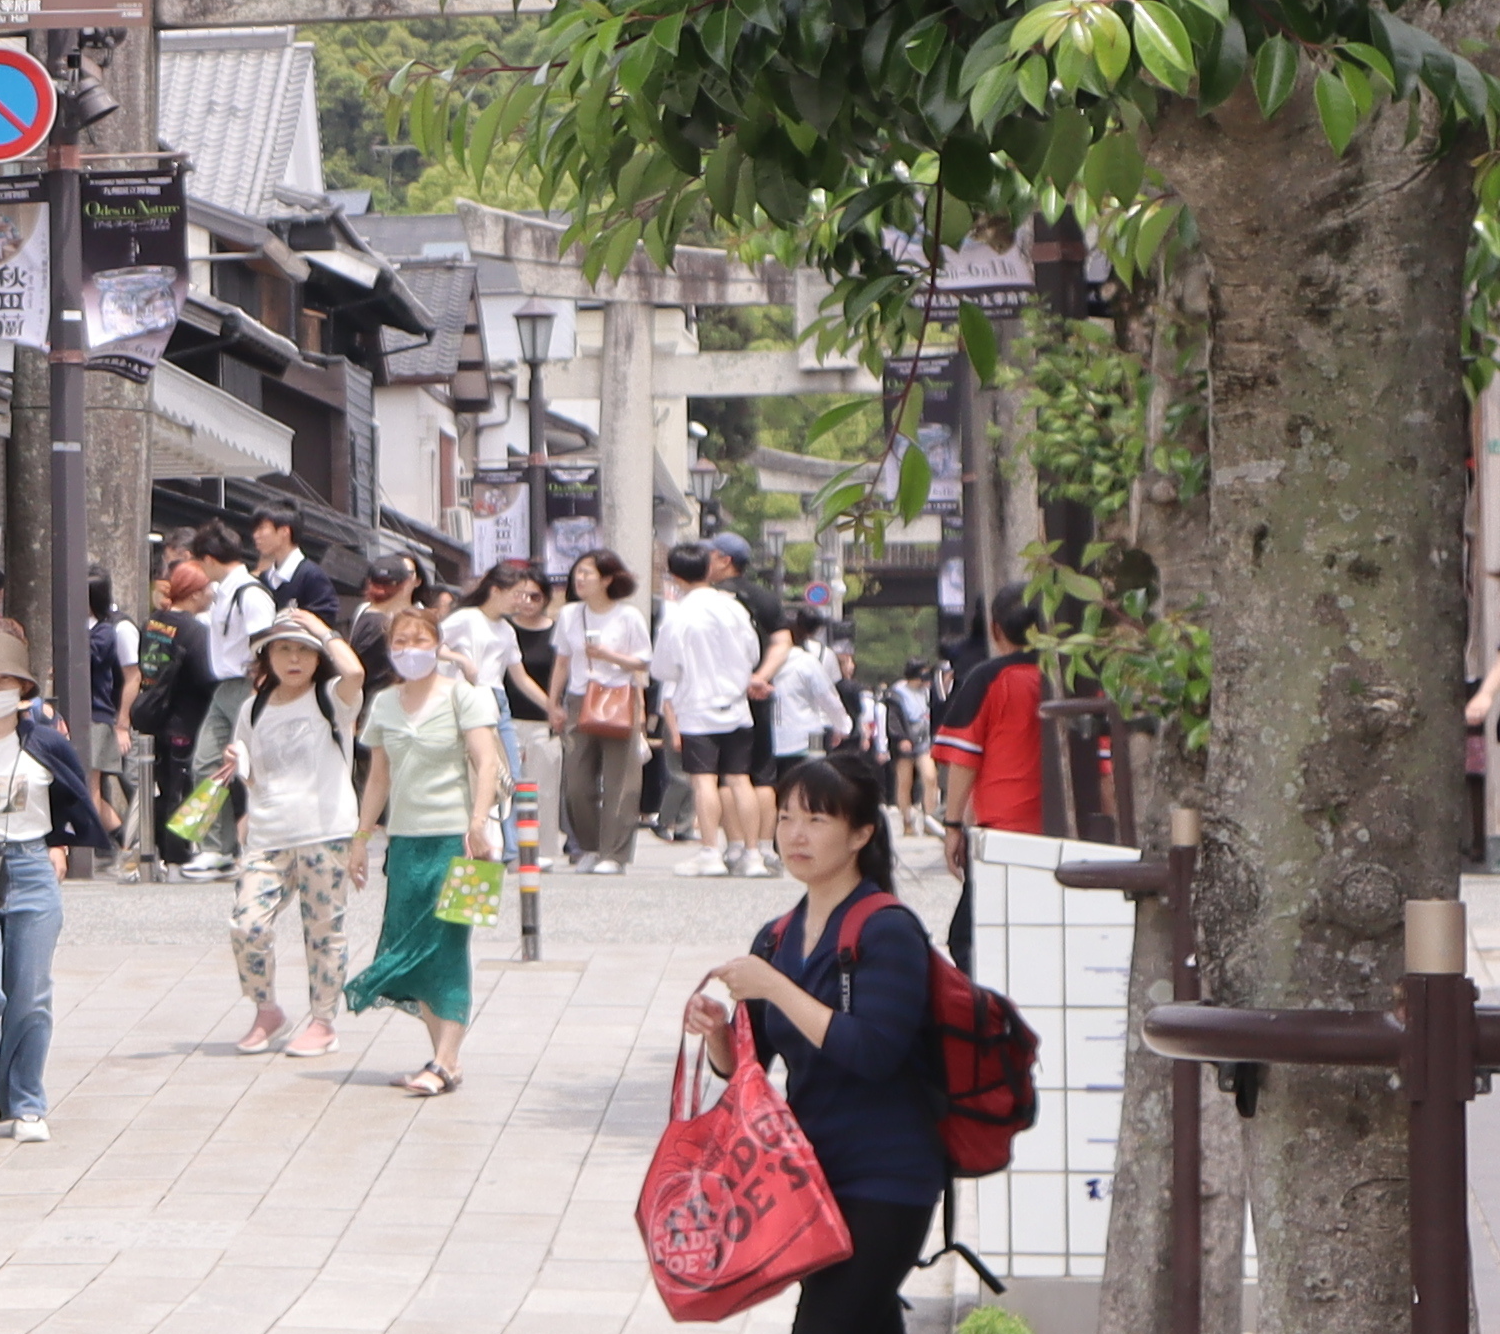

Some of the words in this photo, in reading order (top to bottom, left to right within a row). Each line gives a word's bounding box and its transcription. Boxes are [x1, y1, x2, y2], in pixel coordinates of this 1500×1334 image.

[11, 14, 29, 23] Hall
[123, 206, 135, 216] to
[138, 199, 180, 216] Nature
